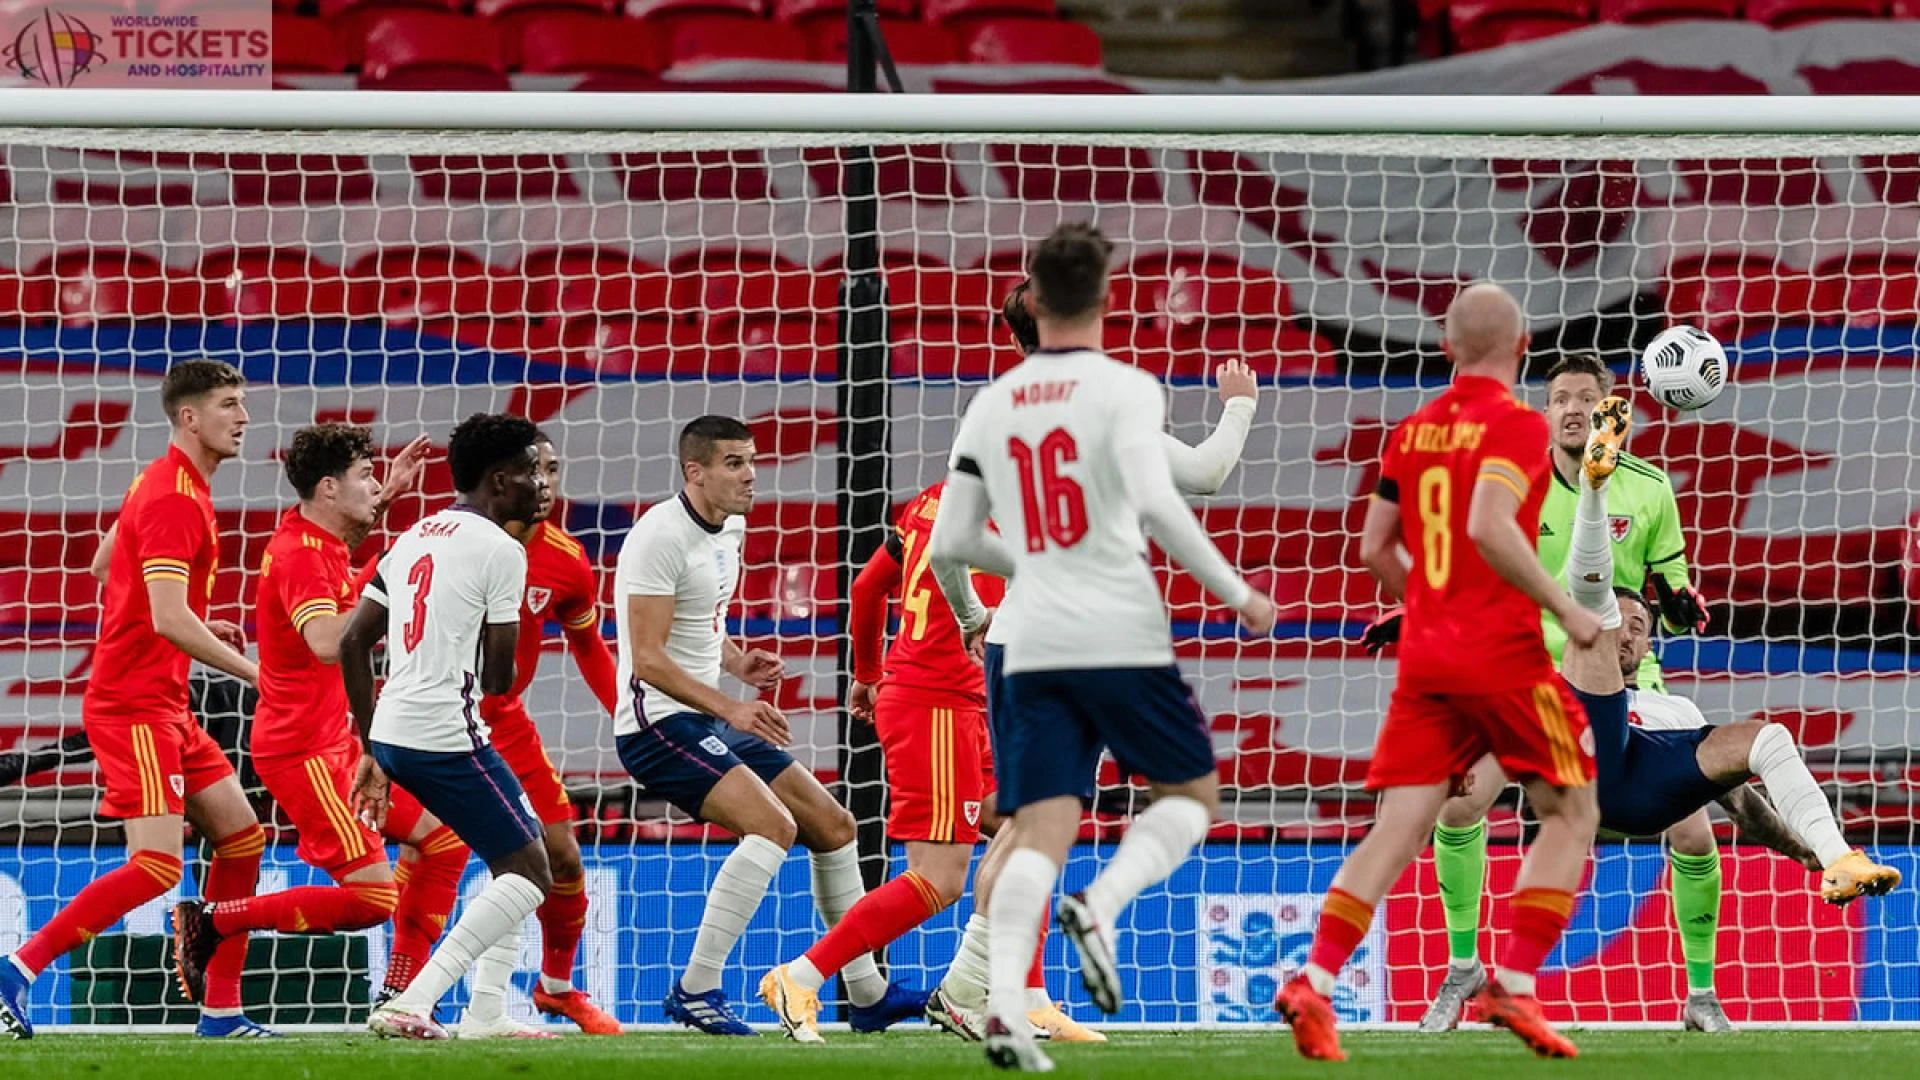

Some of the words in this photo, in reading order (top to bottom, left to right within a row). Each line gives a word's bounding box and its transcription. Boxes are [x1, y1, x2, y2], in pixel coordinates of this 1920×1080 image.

[419, 521, 461, 538] SAKA
[1008, 427, 1089, 553] 16
[1418, 465, 1452, 590] 8
[403, 553, 434, 654] 3
